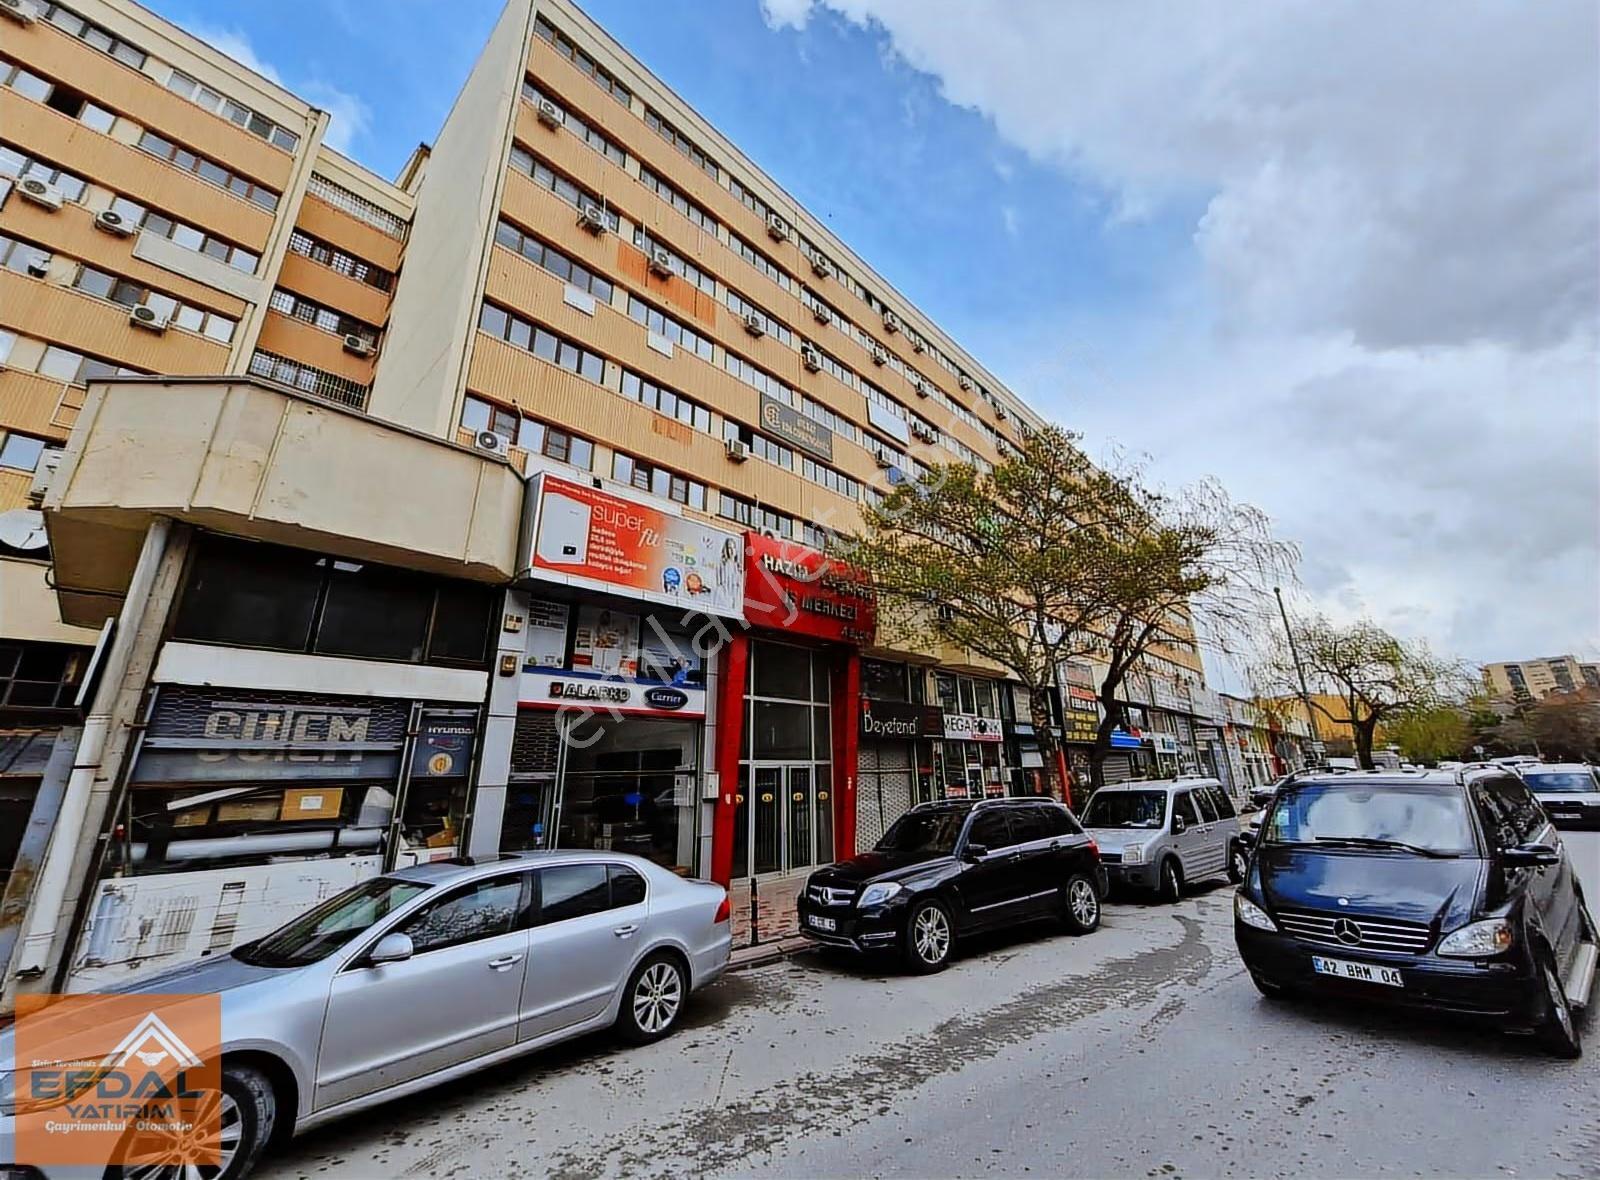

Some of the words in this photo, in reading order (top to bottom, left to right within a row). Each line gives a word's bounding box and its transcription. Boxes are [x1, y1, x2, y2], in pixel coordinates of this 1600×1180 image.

[592, 505, 644, 531] super
[564, 683, 631, 703] ALARKO
[651, 691, 682, 705] Carrier
[1323, 959, 1338, 974] 42
[1346, 964, 1372, 980] BRM
[1381, 970, 1400, 985] 04
